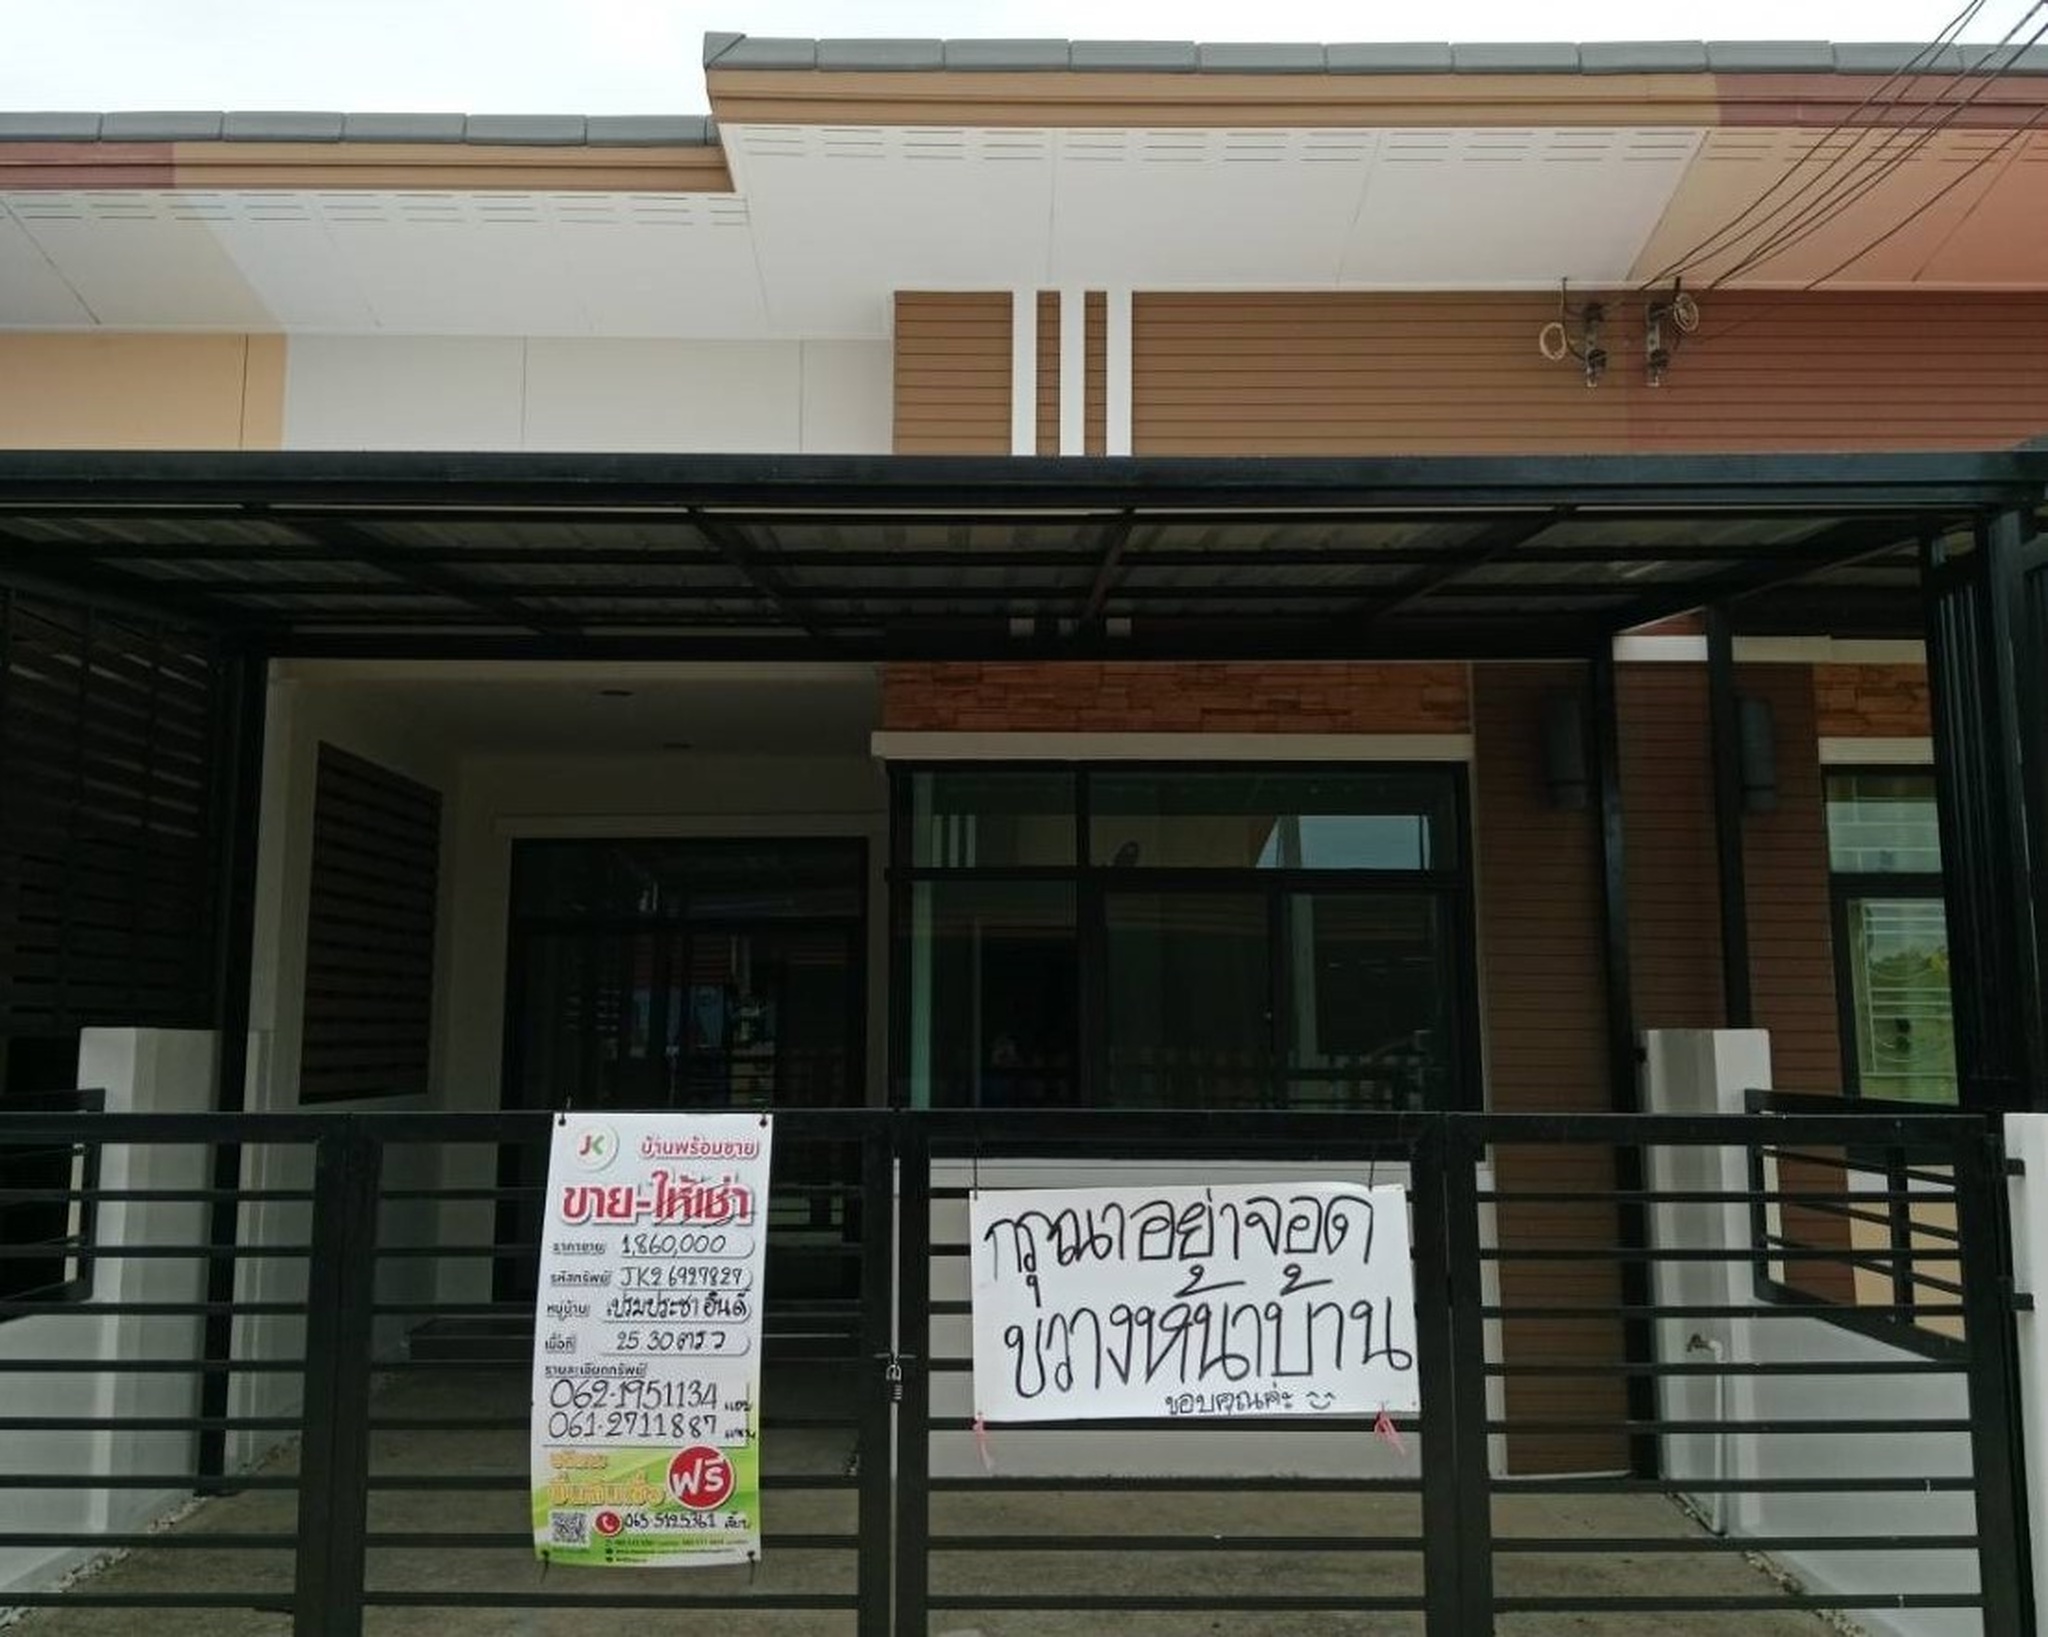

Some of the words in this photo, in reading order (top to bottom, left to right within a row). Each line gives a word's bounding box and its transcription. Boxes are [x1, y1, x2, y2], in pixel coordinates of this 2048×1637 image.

[640, 1135, 758, 1157] บ้านพร้อมขาย
[621, 1233, 726, 1257] 1,860,000
[984, 1188, 1374, 1307] กรุณาอย่าจอด
[1004, 1263, 1413, 1398] ขวางหน้าบ้าน
[671, 1457, 726, 1496] ฟรี
